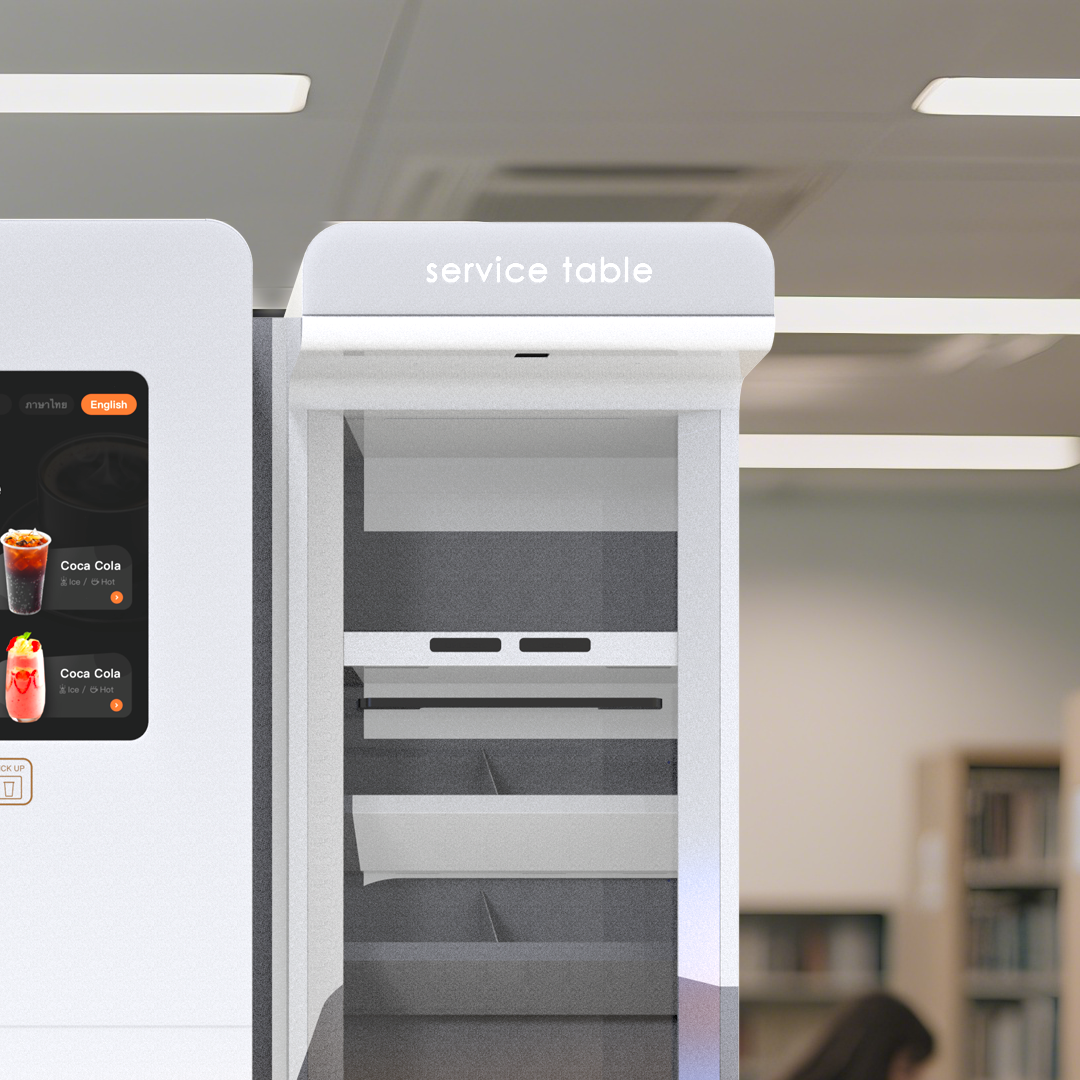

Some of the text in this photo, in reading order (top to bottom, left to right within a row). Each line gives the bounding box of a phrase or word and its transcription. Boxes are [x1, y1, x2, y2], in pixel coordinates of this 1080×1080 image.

[426, 256, 653, 283] service table
[24, 397, 68, 410] ภาษาไทย
[90, 399, 128, 412] English
[60, 560, 121, 571] Coca Cola
[68, 578, 81, 586] Ice
[101, 578, 116, 586] Hot
[60, 668, 121, 679] Coca Cola
[67, 685, 80, 694] Ice
[100, 686, 115, 694] Hot
[13, 764, 26, 773] UP
